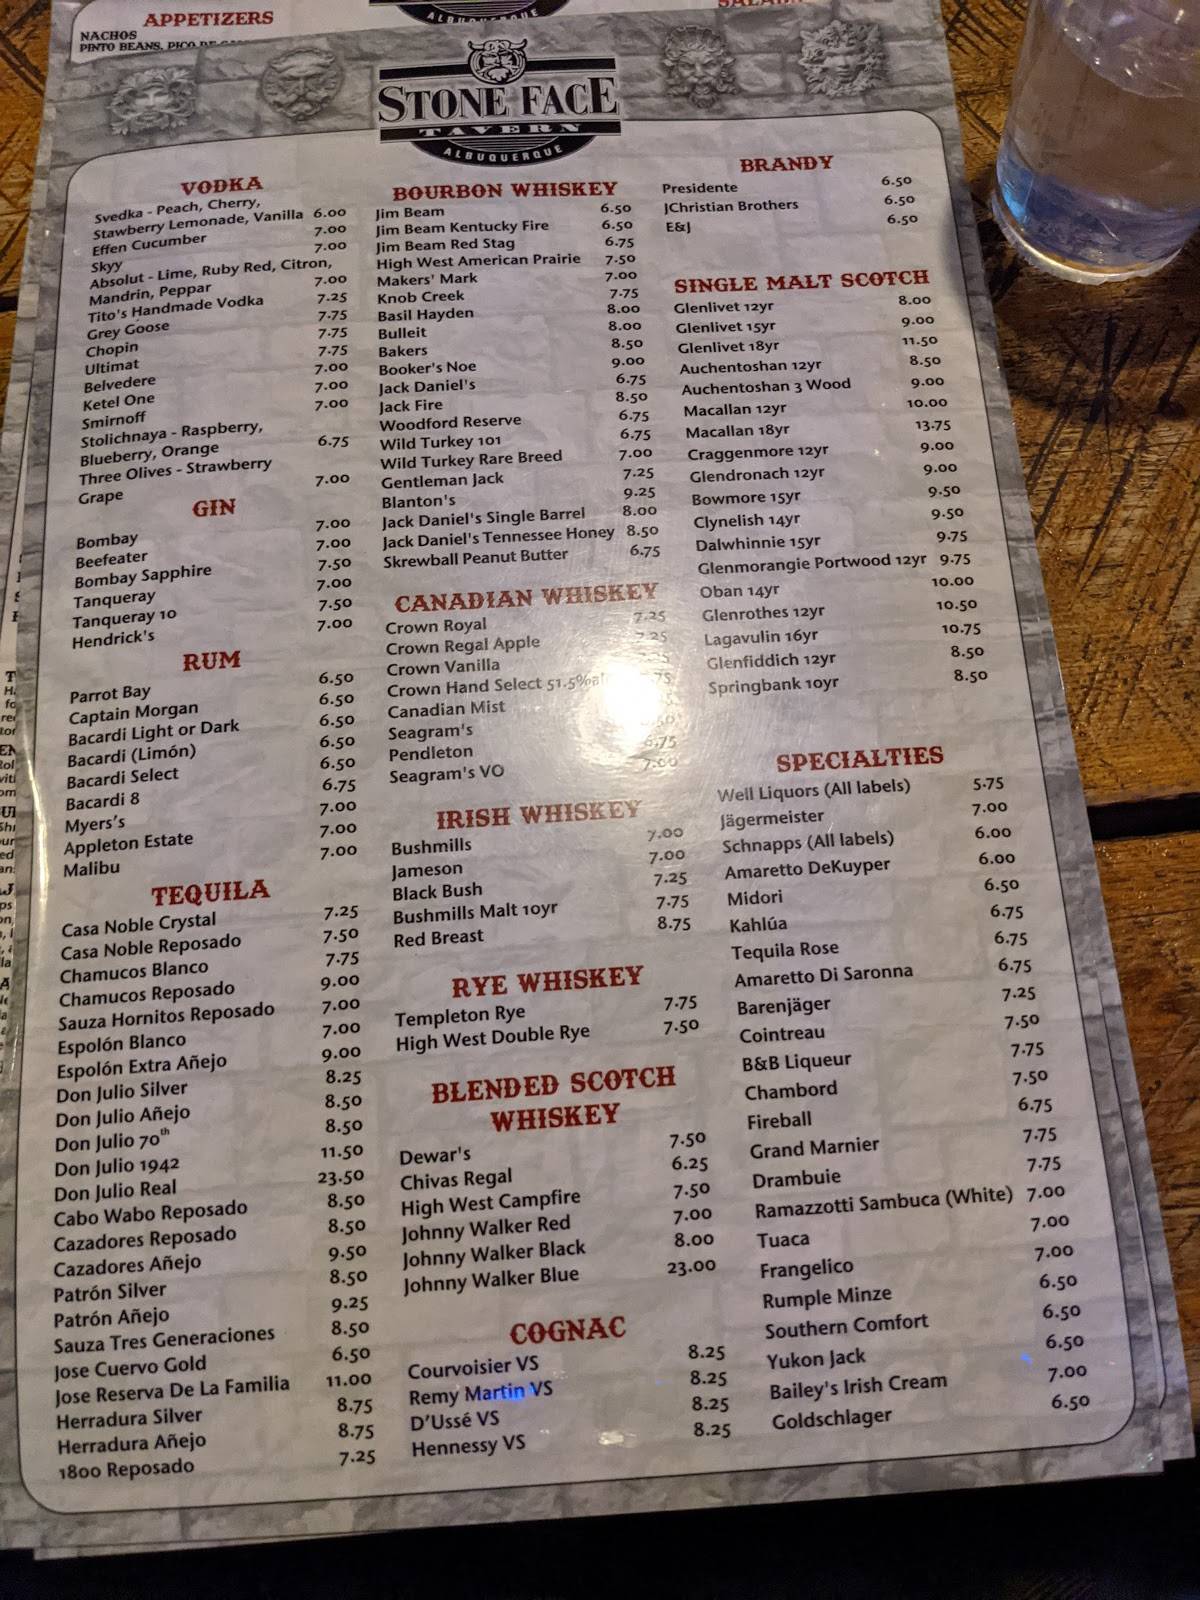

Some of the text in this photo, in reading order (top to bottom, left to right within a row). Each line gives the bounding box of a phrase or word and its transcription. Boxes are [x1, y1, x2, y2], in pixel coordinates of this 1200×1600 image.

[143, 11, 274, 27] APPETIZERS
[80, 30, 137, 42] NACHOS
[79, 42, 116, 53] PINTO
[378, 76, 620, 123] STONE FACE
[419, 123, 582, 137] TAVERN
[443, 143, 563, 162] ALBUQUERQUE
[739, 155, 834, 173] BRANDY
[180, 176, 264, 196] VODKA
[662, 182, 738, 194] Presidente
[881, 175, 913, 188] 6.50
[392, 181, 618, 202] BOURBON WHISKEY
[94, 209, 143, 224] Svedka
[156, 201, 203, 216] Peach,
[207, 198, 261, 210] Cherry,
[313, 208, 346, 219] 6.00
[375, 207, 445, 222] Jim Beam
[600, 202, 632, 215] 6.50
[664, 199, 799, 216] JChristian Brothers
[92, 209, 304, 241] Stawberry Lemonade, Vanilla
[666, 221, 691, 234] E&J
[376, 253, 581, 273] High West American Prairie
[605, 254, 636, 266] 7.50
[89, 273, 145, 290] Absolut
[157, 269, 197, 281] Lime,
[202, 263, 240, 277] Ruby
[243, 260, 276, 273] Red,
[280, 258, 332, 270] Citron,
[674, 269, 930, 294] SINGLE MALT SCOTCH
[317, 292, 348, 304] 7.25
[898, 295, 932, 306] 8.00
[87, 295, 264, 324] Tito's Handmade Vodka
[673, 301, 775, 315] Glenlivet 12yr
[681, 377, 852, 396] Auchentoshan 3 Wood
[910, 377, 945, 389] 9.00
[81, 410, 147, 430] Smirnoff
[78, 472, 122, 486] Three
[125, 466, 172, 480] Olives
[186, 458, 272, 474] Strawberry
[315, 474, 350, 487] 7.00
[381, 471, 504, 490] Gentleman Jack
[192, 498, 236, 517] GIN
[76, 533, 139, 550] Bombay
[318, 558, 352, 572] 7.50
[698, 553, 927, 575] Glenmorangie Portwood 12yr
[939, 553, 971, 566] 9.75
[394, 582, 659, 613] CANADIAN WHISKEY
[704, 628, 819, 649] Lagavulin 16yr
[941, 622, 981, 636] 10.75
[72, 629, 155, 650] Hendrick's
[386, 635, 540, 656] Crown Regal Apple
[182, 650, 241, 672] RUM
[319, 692, 355, 708] 6.50
[69, 703, 199, 727] Captain Morgan
[67, 743, 196, 768] Bacardi (Limón)
[776, 746, 944, 773] SPECIALTIES
[436, 800, 642, 830] IRISH WHISKEY
[320, 823, 357, 838] 7.00
[975, 826, 1012, 839] 6.00
[63, 833, 194, 859] Appleton Estate
[722, 830, 894, 855] Schnapps (All labels)
[654, 871, 687, 887] 7.25
[151, 879, 271, 907] TEQUILA
[393, 881, 483, 902] Black Bush
[324, 905, 359, 921] 7.25
[990, 904, 1024, 920] 6.75
[61, 911, 216, 938] Casa Noble Crystal
[729, 916, 788, 933] Kahlúa
[451, 965, 644, 999] RYE WHISKEY
[1001, 986, 1036, 1002] 7.25
[737, 997, 831, 1017] Barenjäger
[663, 1019, 699, 1035] 7.50
[396, 1024, 590, 1055] High West Double Rye
[57, 1053, 227, 1083] Espolón Extra Añejo
[431, 1065, 677, 1104] BLENDED SCOTCH
[490, 1102, 621, 1132] WHISKEY
[55, 1157, 180, 1178] Don Julio 1942
[318, 1169, 365, 1187] 23.50
[755, 1185, 1013, 1219] Ramazzotti Sambuca (White)
[1026, 1185, 1066, 1203] 7.00
[674, 1232, 714, 1248] 8.00
[403, 1238, 586, 1271] Johnny Walker Black
[1042, 1303, 1081, 1322] 6.50
[509, 1316, 626, 1345] COGNAC
[765, 1313, 930, 1340] Southern Comfort
[326, 1373, 372, 1388] 11.00
[770, 1375, 948, 1403] Bailey's Irish Cream
[55, 1375, 290, 1409] Jose Reserva De La Familia
[409, 1380, 553, 1408] Remy Martin VS
[1051, 1393, 1090, 1411] 6.50
[339, 1449, 376, 1467] 7.25
[59, 1457, 195, 1481] 1800 Reposado
